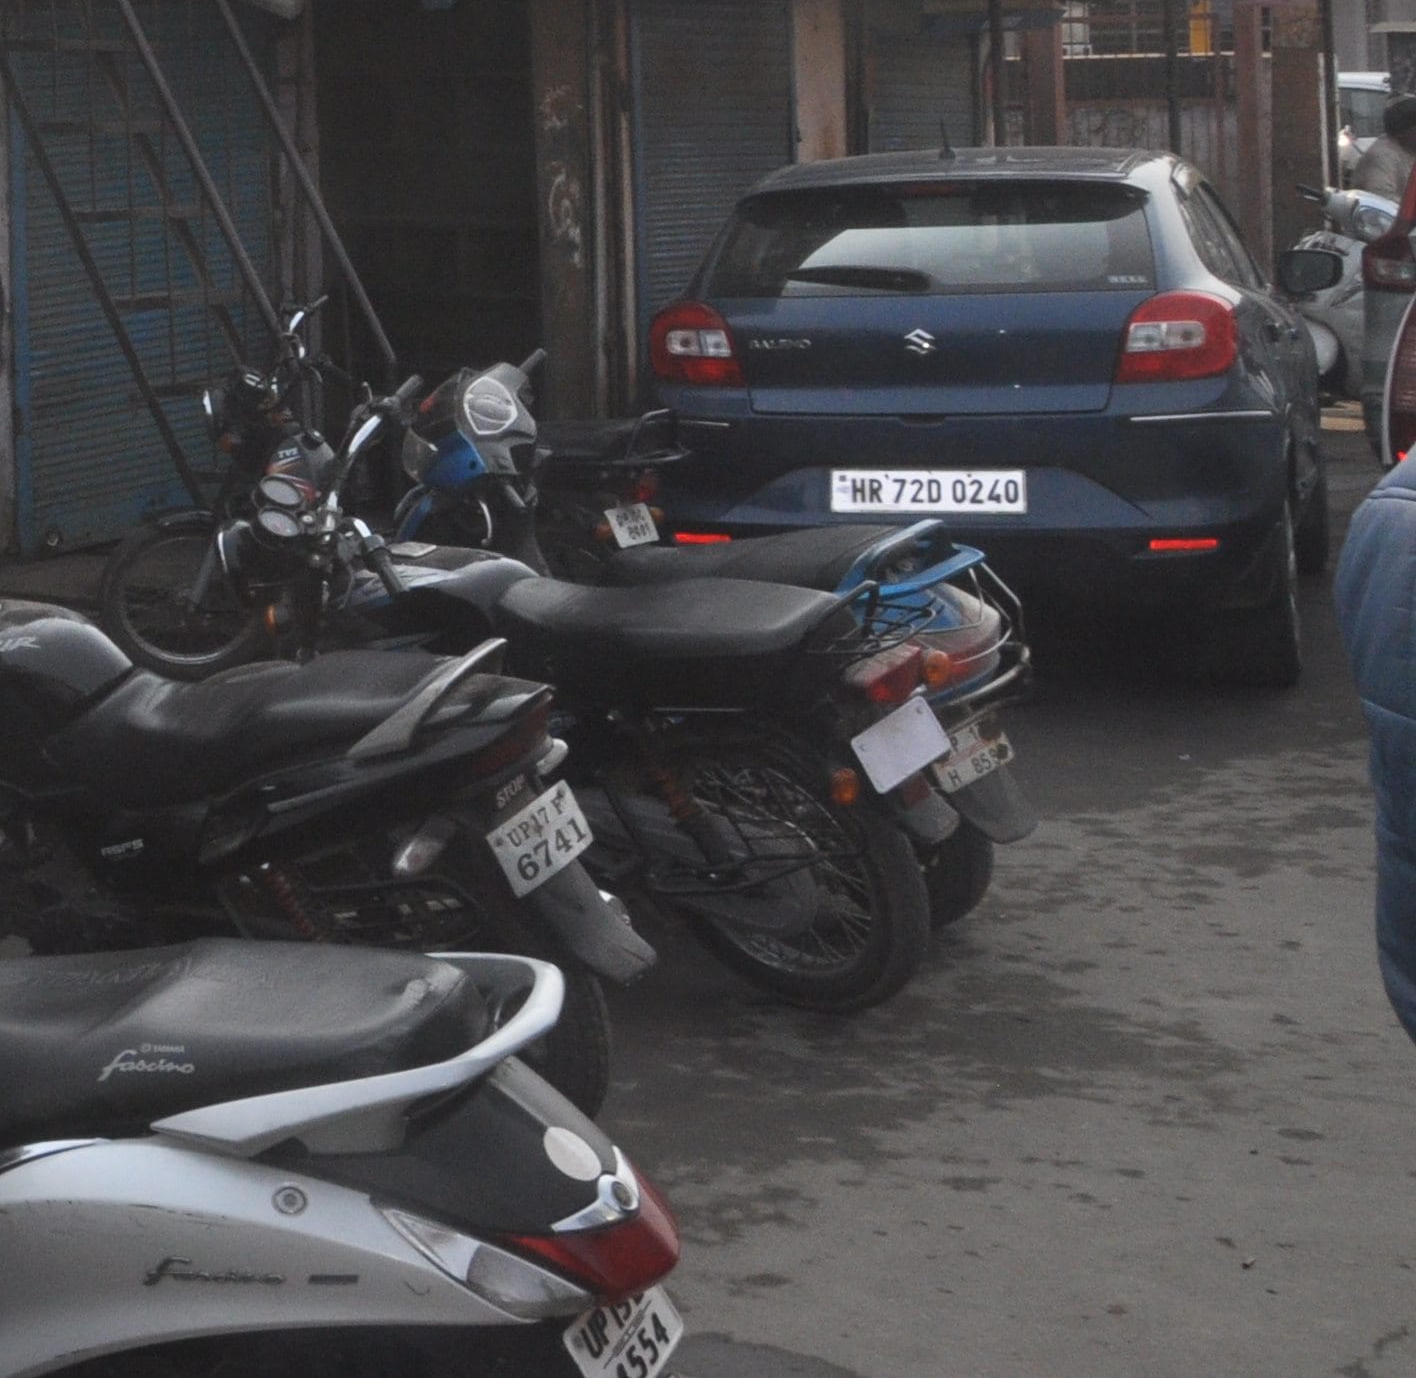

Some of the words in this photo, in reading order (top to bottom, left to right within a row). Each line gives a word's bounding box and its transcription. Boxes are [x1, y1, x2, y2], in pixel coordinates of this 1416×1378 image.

[850, 477, 883, 504] HR
[892, 477, 942, 505] 72D
[951, 477, 1019, 505] 0240
[516, 817, 587, 882] 6741
